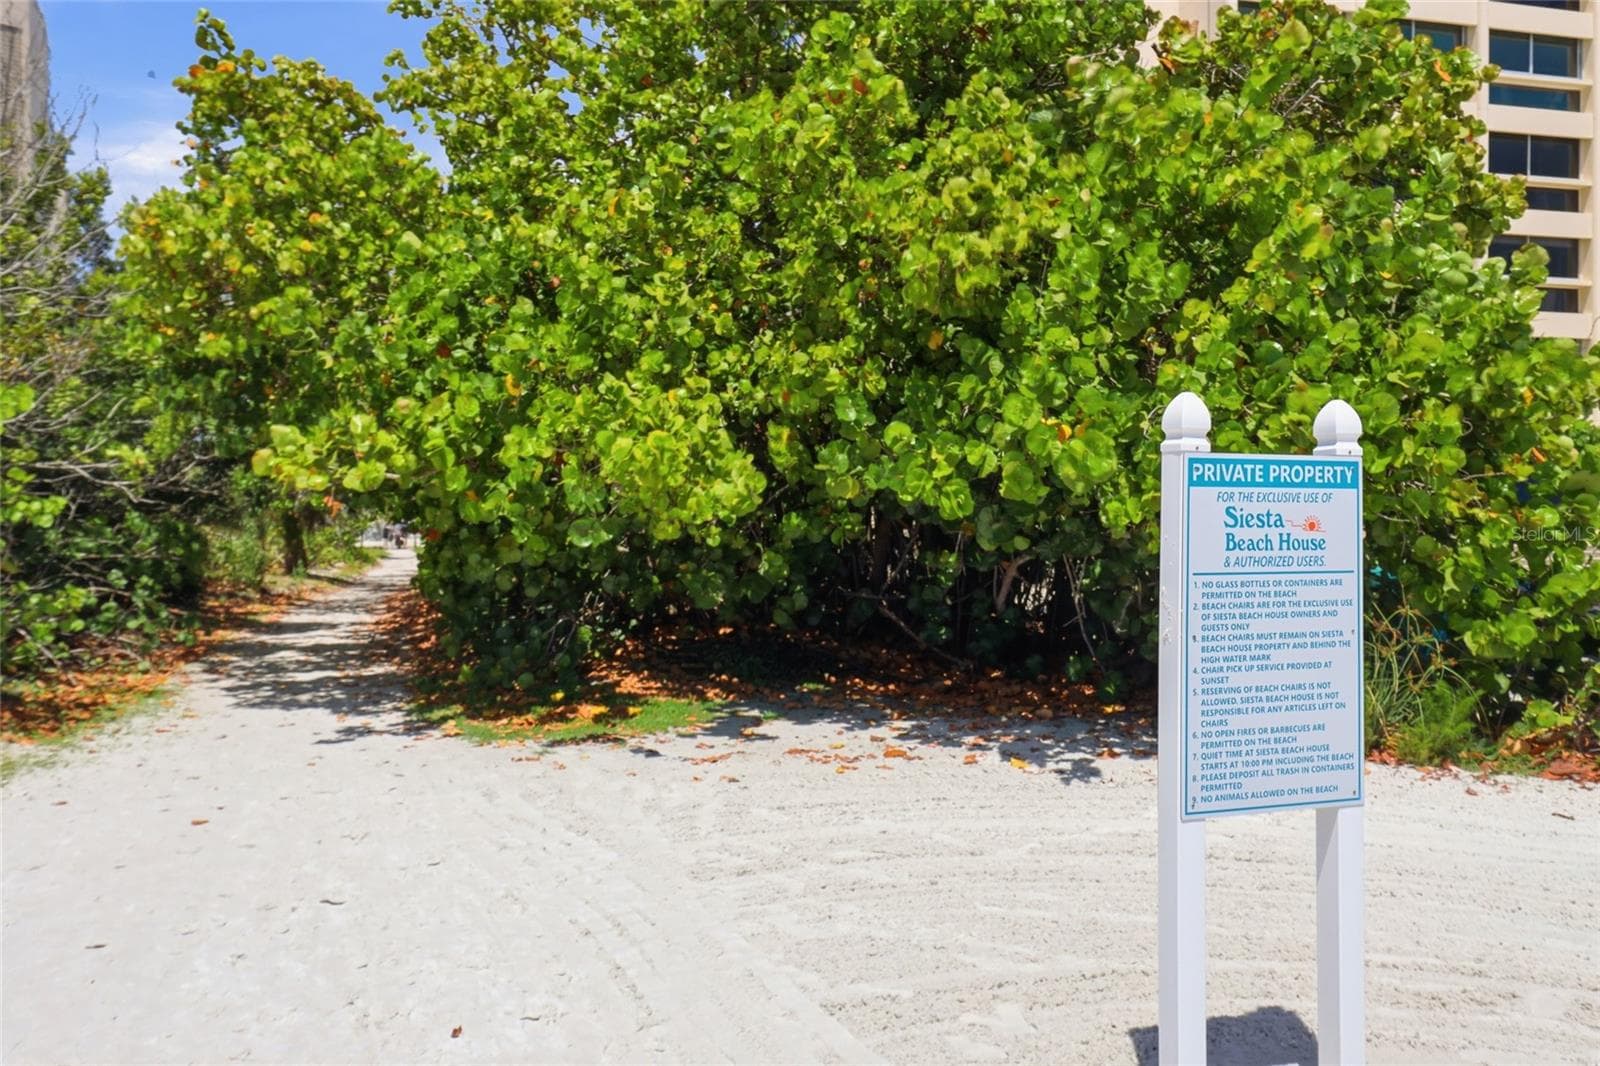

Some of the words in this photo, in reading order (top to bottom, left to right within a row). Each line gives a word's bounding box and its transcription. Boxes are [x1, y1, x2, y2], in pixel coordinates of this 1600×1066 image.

[1193, 464, 1264, 482] PRIVATE
[1269, 465, 1353, 484] PROPERTY
[1217, 492, 1234, 502] FOR
[1239, 492, 1253, 502] THE
[1257, 492, 1301, 503] EXCLUSIVE
[1304, 493, 1319, 503] USE
[1321, 493, 1333, 502] OF
[1224, 506, 1284, 528] Siesta
[1226, 533, 1273, 551] Beach
[1279, 534, 1326, 551] House
[1224, 557, 1230, 567] &
[1234, 556, 1293, 567] AUTHORIZED
[1202, 602, 1226, 610] BEACH
[1202, 634, 1226, 642] BEACH
[1254, 643, 1290, 651] PROPERTY
[1201, 666, 1224, 674] CHAIR
[1256, 664, 1284, 672] SERVICE
[1287, 662, 1322, 670] PROVIDED
[1202, 687, 1242, 696] RESERVING
[1255, 685, 1279, 693] BEACH
[1291, 694, 1315, 702] HOUSE
[1201, 708, 1249, 717] RESPONSIBLE
[1285, 704, 1316, 713] ARTICLES
[1201, 719, 1228, 728] CHAIRS
[1271, 725, 1310, 734] BARBECUES
[1201, 740, 1242, 749] PERMITTED
[1274, 736, 1297, 744] BEACH
[1201, 752, 1223, 760] QUIET
[1256, 748, 1279, 756] SIESTA
[1306, 744, 1330, 753] HOUSE
[1201, 762, 1227, 770] STARTS
[1276, 756, 1314, 766] INCLUDING
[1332, 753, 1353, 762] BEACH
[1201, 773, 1226, 782] PLEASE
[1229, 771, 1259, 780] DEPOSIT
[1277, 767, 1299, 776] TRASH
[1311, 763, 1354, 773] CONTAINERS
[1201, 783, 1242, 792] PERMITTED
[1215, 792, 1249, 802] ANIMALS
[1252, 790, 1284, 799] ALLOWED
[1316, 785, 1338, 794] BEACH
